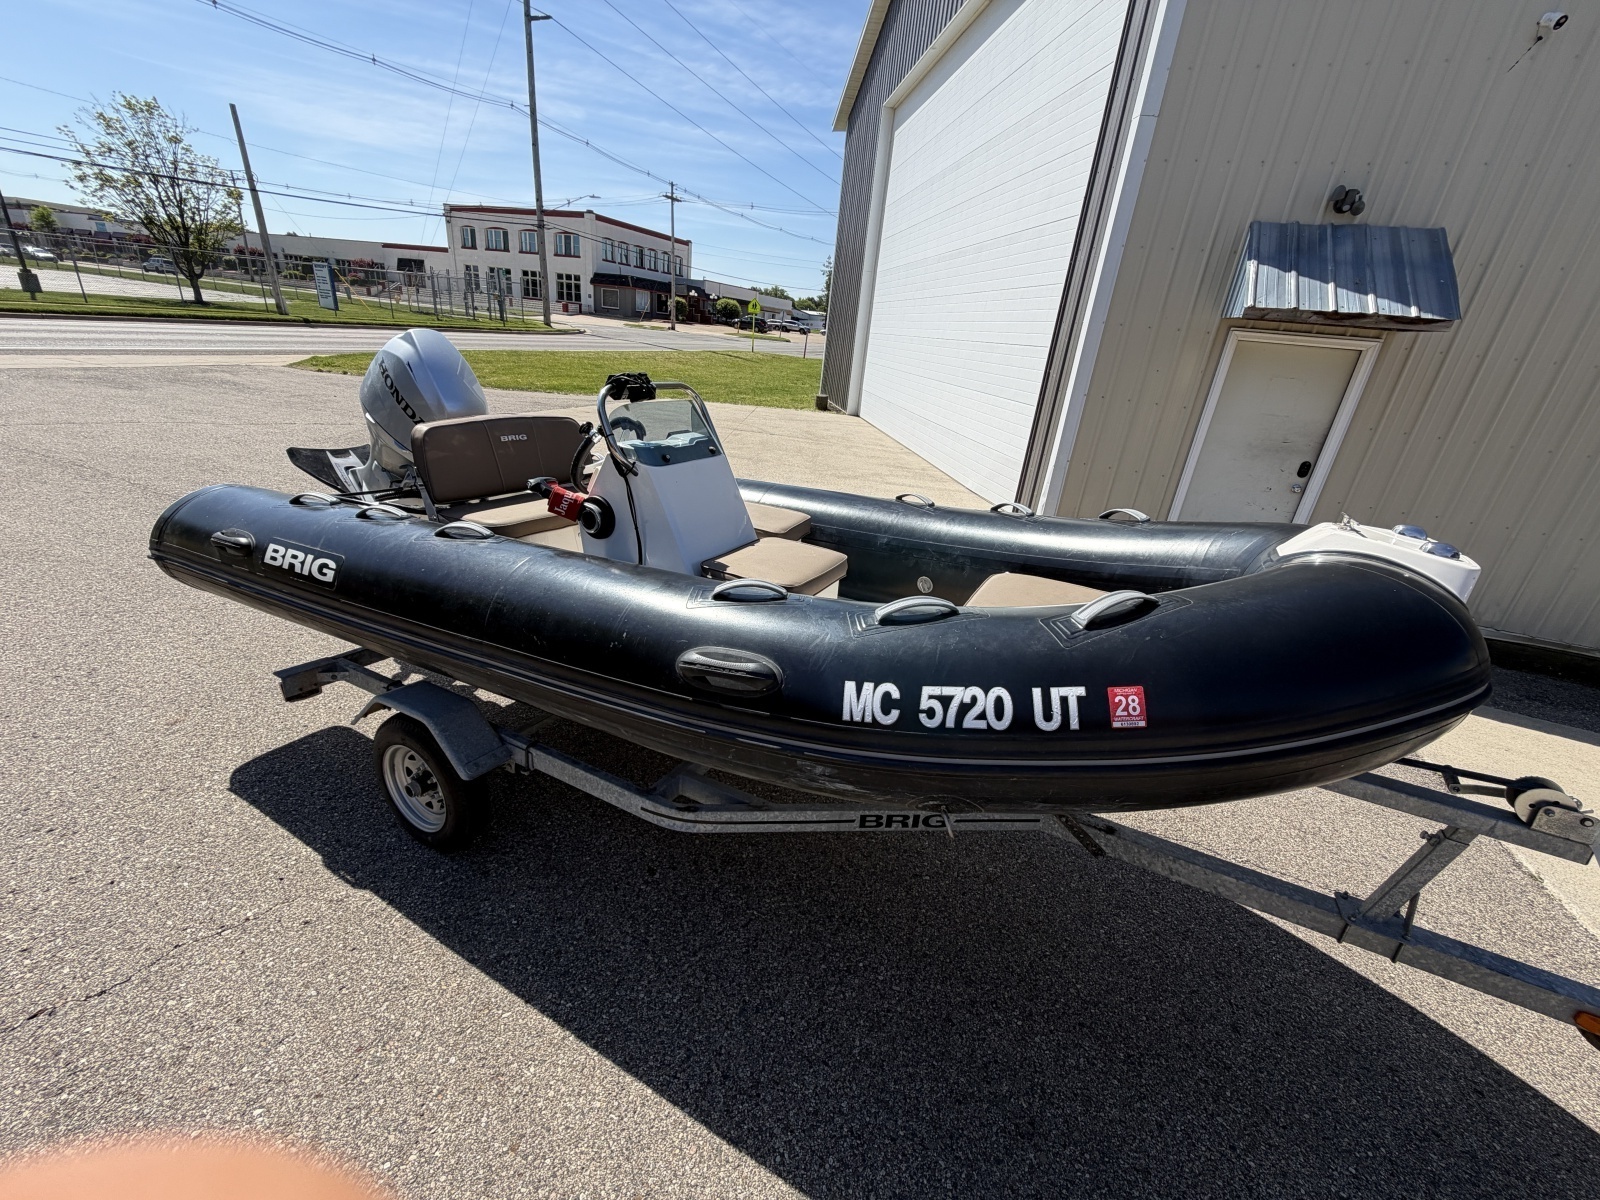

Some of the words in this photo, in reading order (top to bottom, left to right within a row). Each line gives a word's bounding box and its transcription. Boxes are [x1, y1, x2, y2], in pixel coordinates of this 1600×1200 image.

[500, 434, 528, 442] BRIG
[263, 543, 337, 583] BRIG
[842, 680, 901, 726] MC
[918, 686, 1014, 731] 5720
[1031, 686, 1087, 731] UT
[1114, 695, 1141, 716] 28
[859, 814, 947, 829] BRIG
